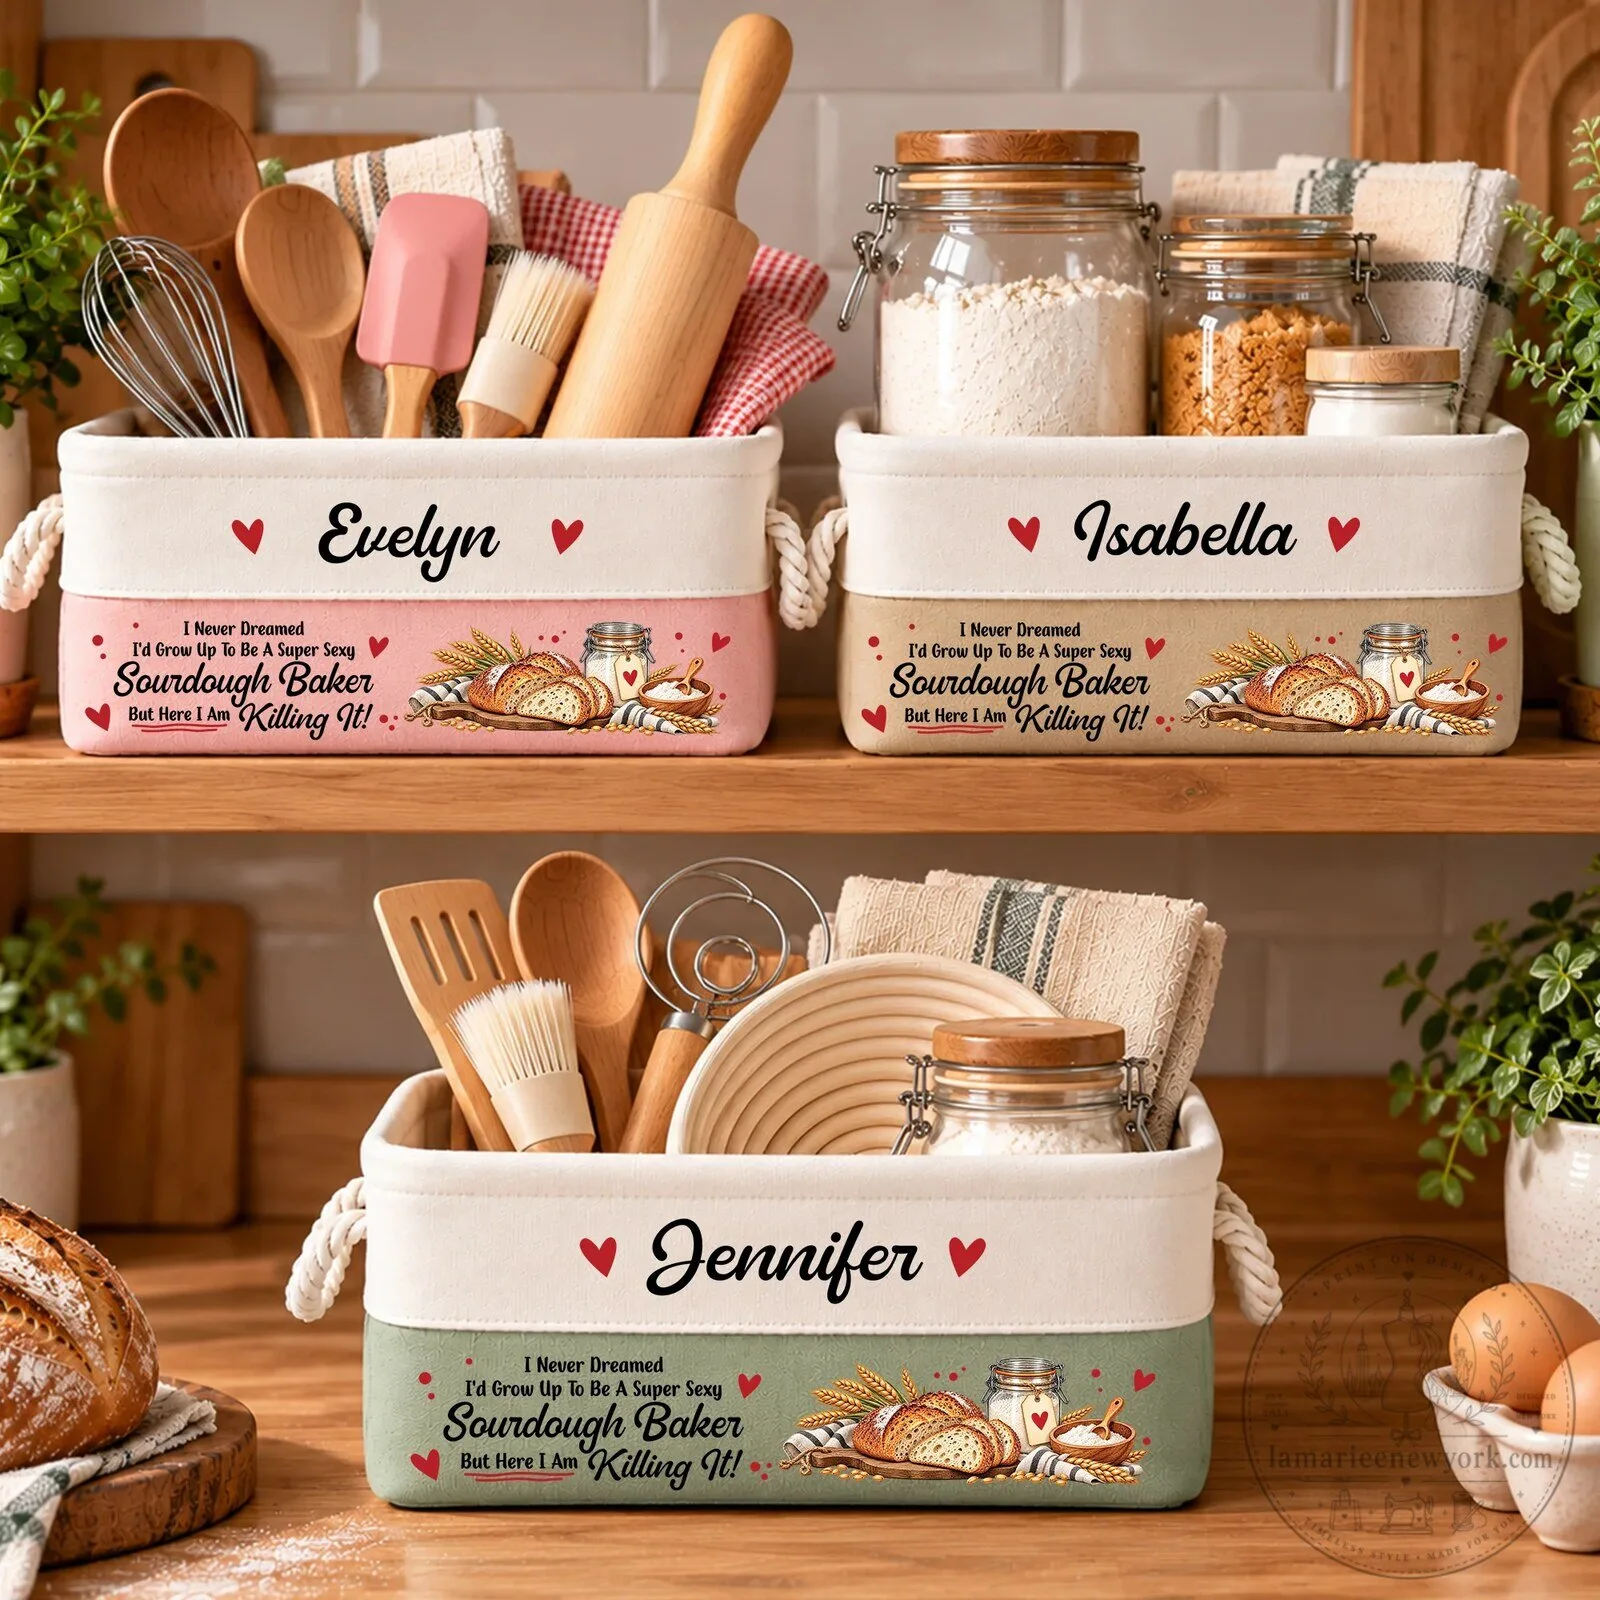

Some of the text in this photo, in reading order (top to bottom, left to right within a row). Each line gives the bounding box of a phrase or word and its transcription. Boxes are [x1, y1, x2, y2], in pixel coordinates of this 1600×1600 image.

[318, 502, 501, 583] Evelyn
[1073, 499, 1298, 562] Isabella
[183, 621, 305, 637] I Never Dreamed
[959, 621, 1081, 638] I Never Dreamed
[132, 641, 356, 662] I'd Grow Up To Be A Super Sexy
[908, 642, 1132, 663] I'd Grow Up To Be A Super Sexy
[113, 660, 374, 708] Sourdough Baker
[889, 662, 1151, 710] Sourdough Baker
[128, 702, 374, 741] But Here I Am Killing It!
[904, 703, 1150, 741] But Here I Am Killing It!
[646, 1218, 924, 1305] Jennifer
[524, 1355, 664, 1374] I Never Dreamed
[465, 1379, 723, 1402] I'd Grow Up To Be A Super Sexy
[442, 1401, 745, 1455] Sourdough Baker
[460, 1447, 744, 1491] But Here I Am Killing It!
